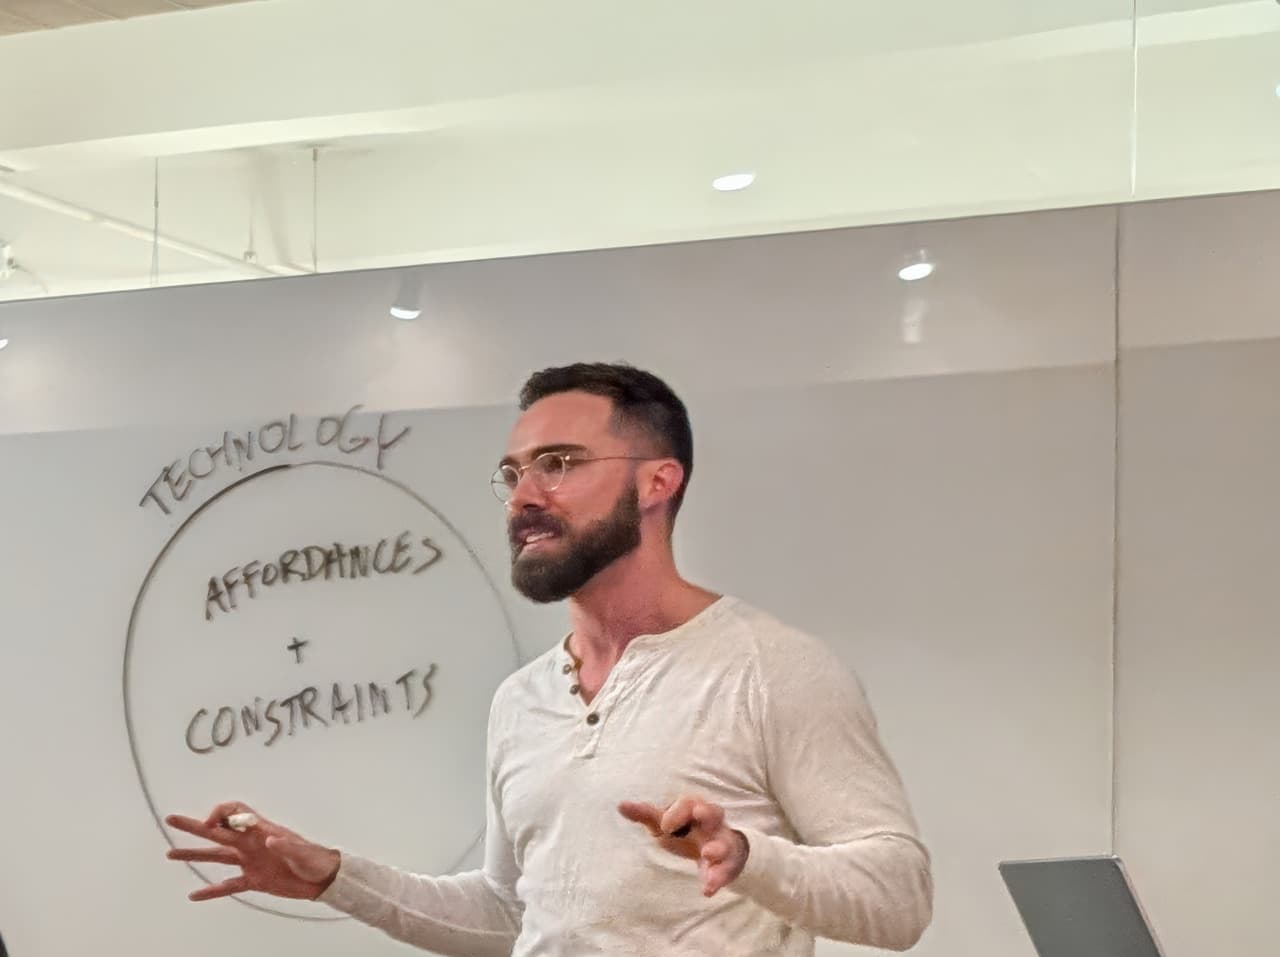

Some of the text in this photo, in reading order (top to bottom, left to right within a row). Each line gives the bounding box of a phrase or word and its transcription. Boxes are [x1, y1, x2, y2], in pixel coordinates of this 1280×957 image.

[139, 404, 411, 515] TECHNOLOGY
[204, 529, 443, 621] AFFORDANCES
[287, 636, 309, 664] +
[185, 663, 439, 755] CONSTRAINTS
